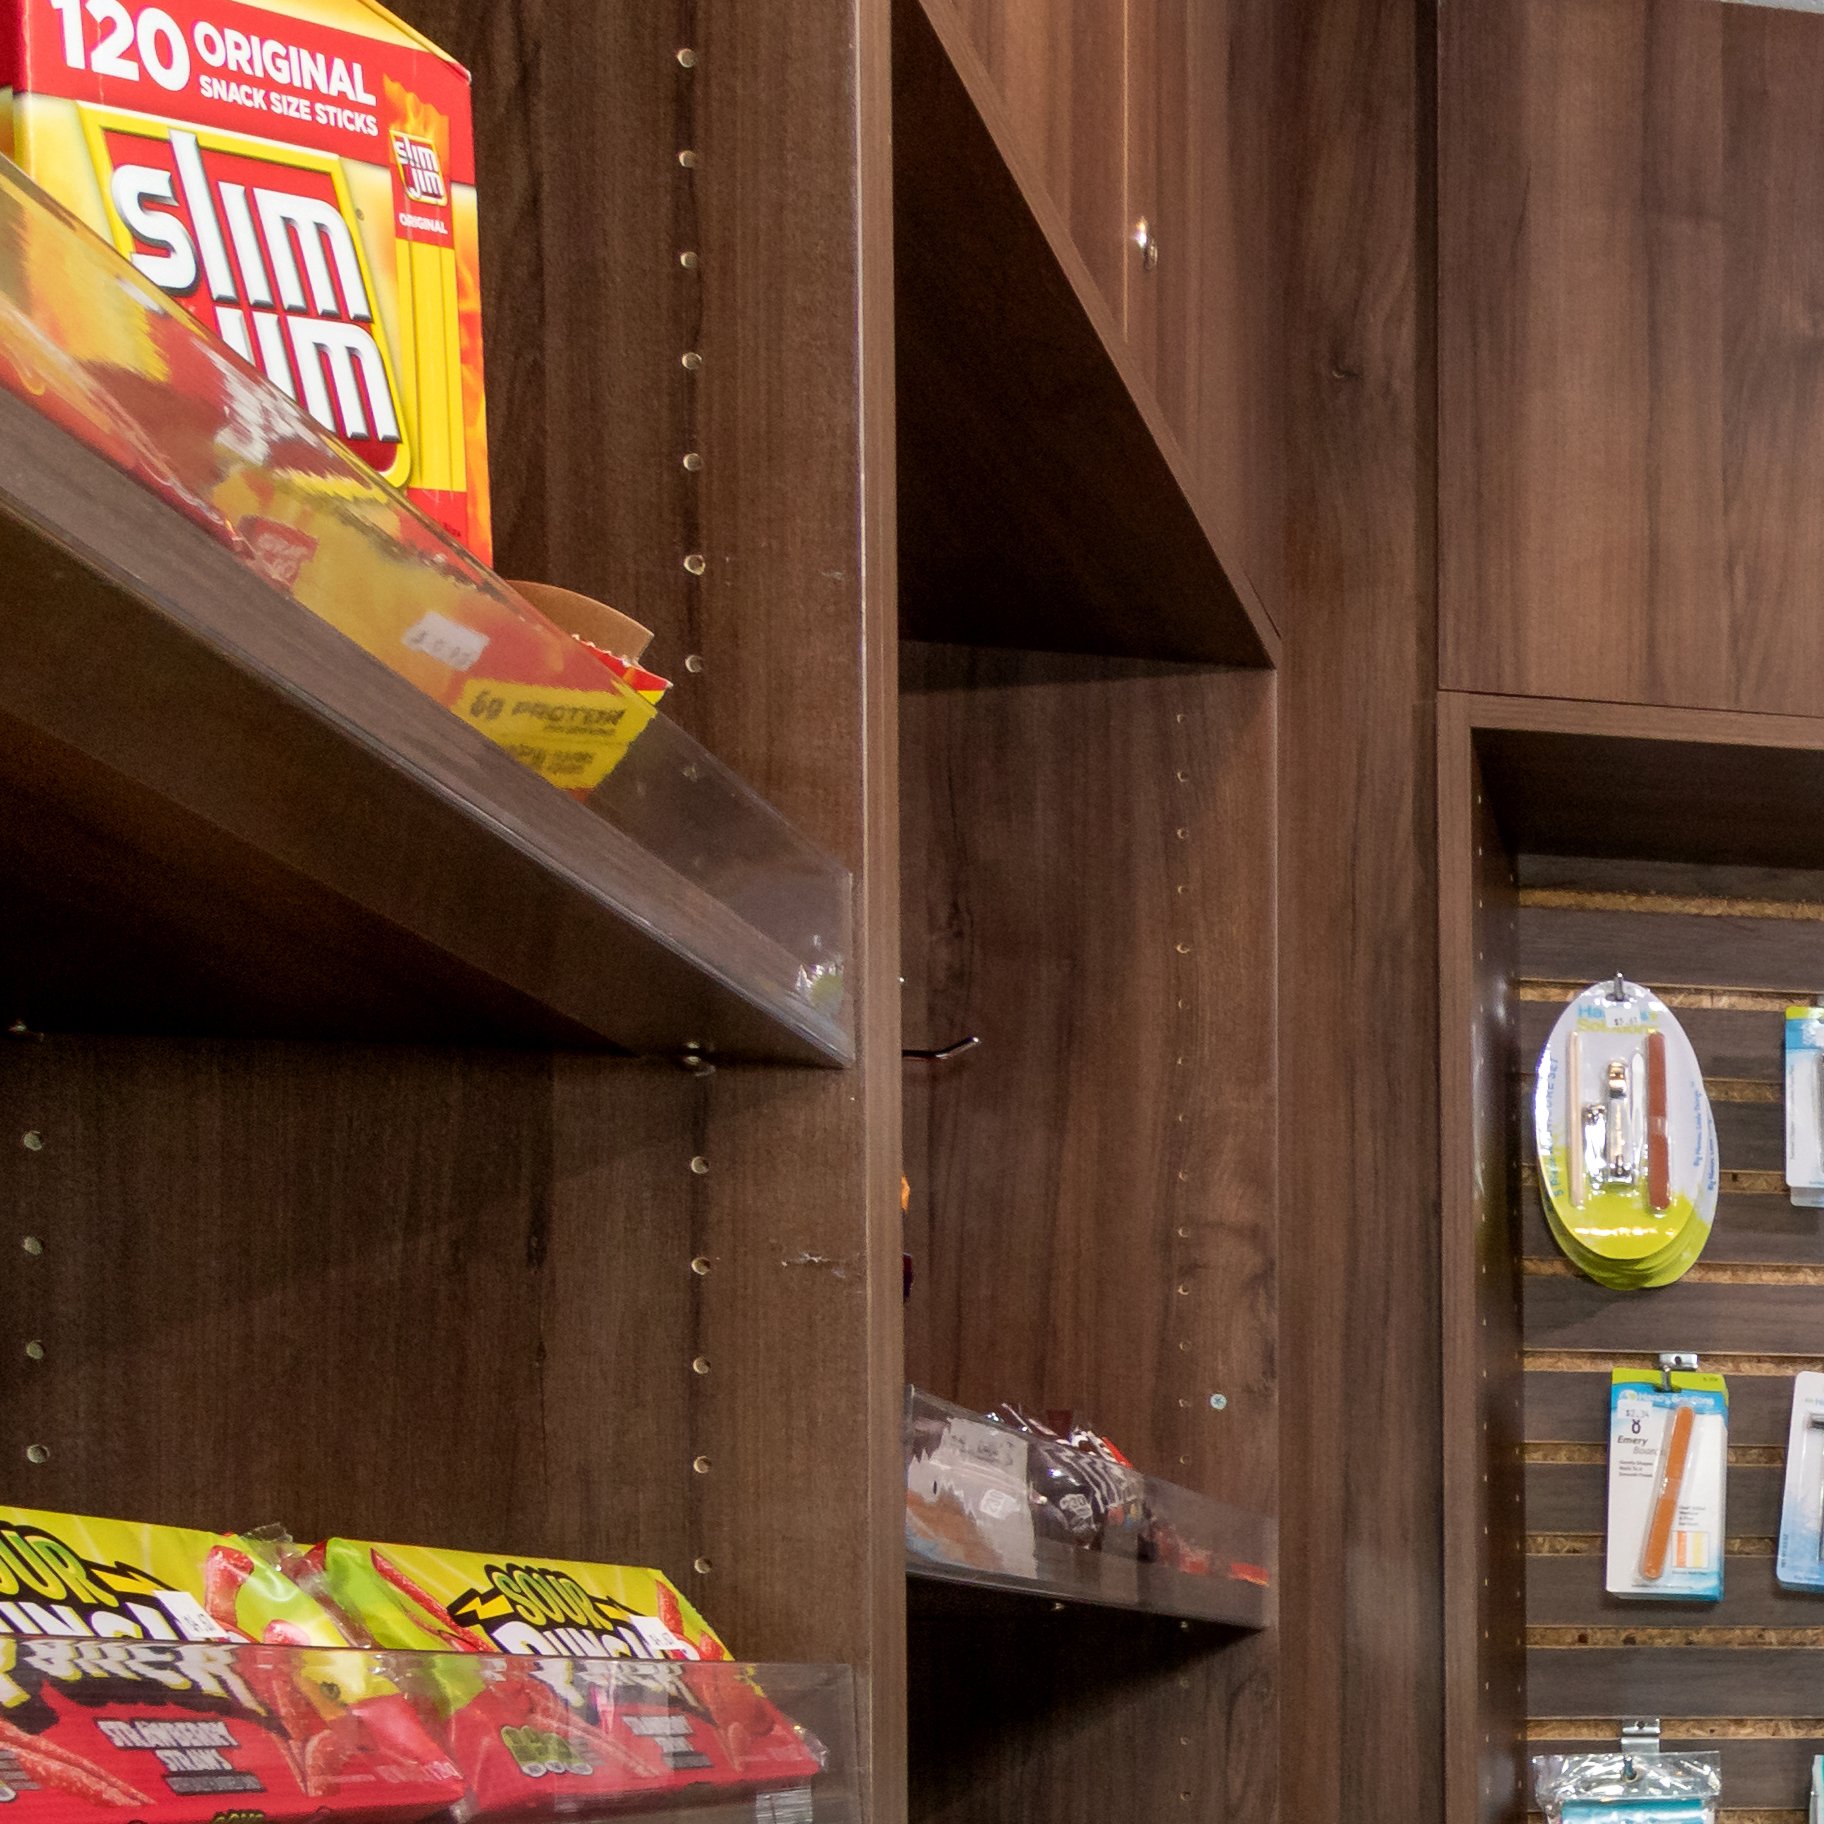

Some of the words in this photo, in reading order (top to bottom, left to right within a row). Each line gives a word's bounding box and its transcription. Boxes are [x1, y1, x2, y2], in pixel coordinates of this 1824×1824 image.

[52, 0, 192, 92] 120
[193, 21, 378, 107] ORIGINAL
[199, 75, 268, 111] SNACK
[270, 94, 312, 121] SIZE
[315, 103, 379, 138] STICKS
[398, 211, 449, 236] ORIGINAL
[1616, 1435, 1649, 1448] Emery
[491, 1568, 611, 1631] SOUR
